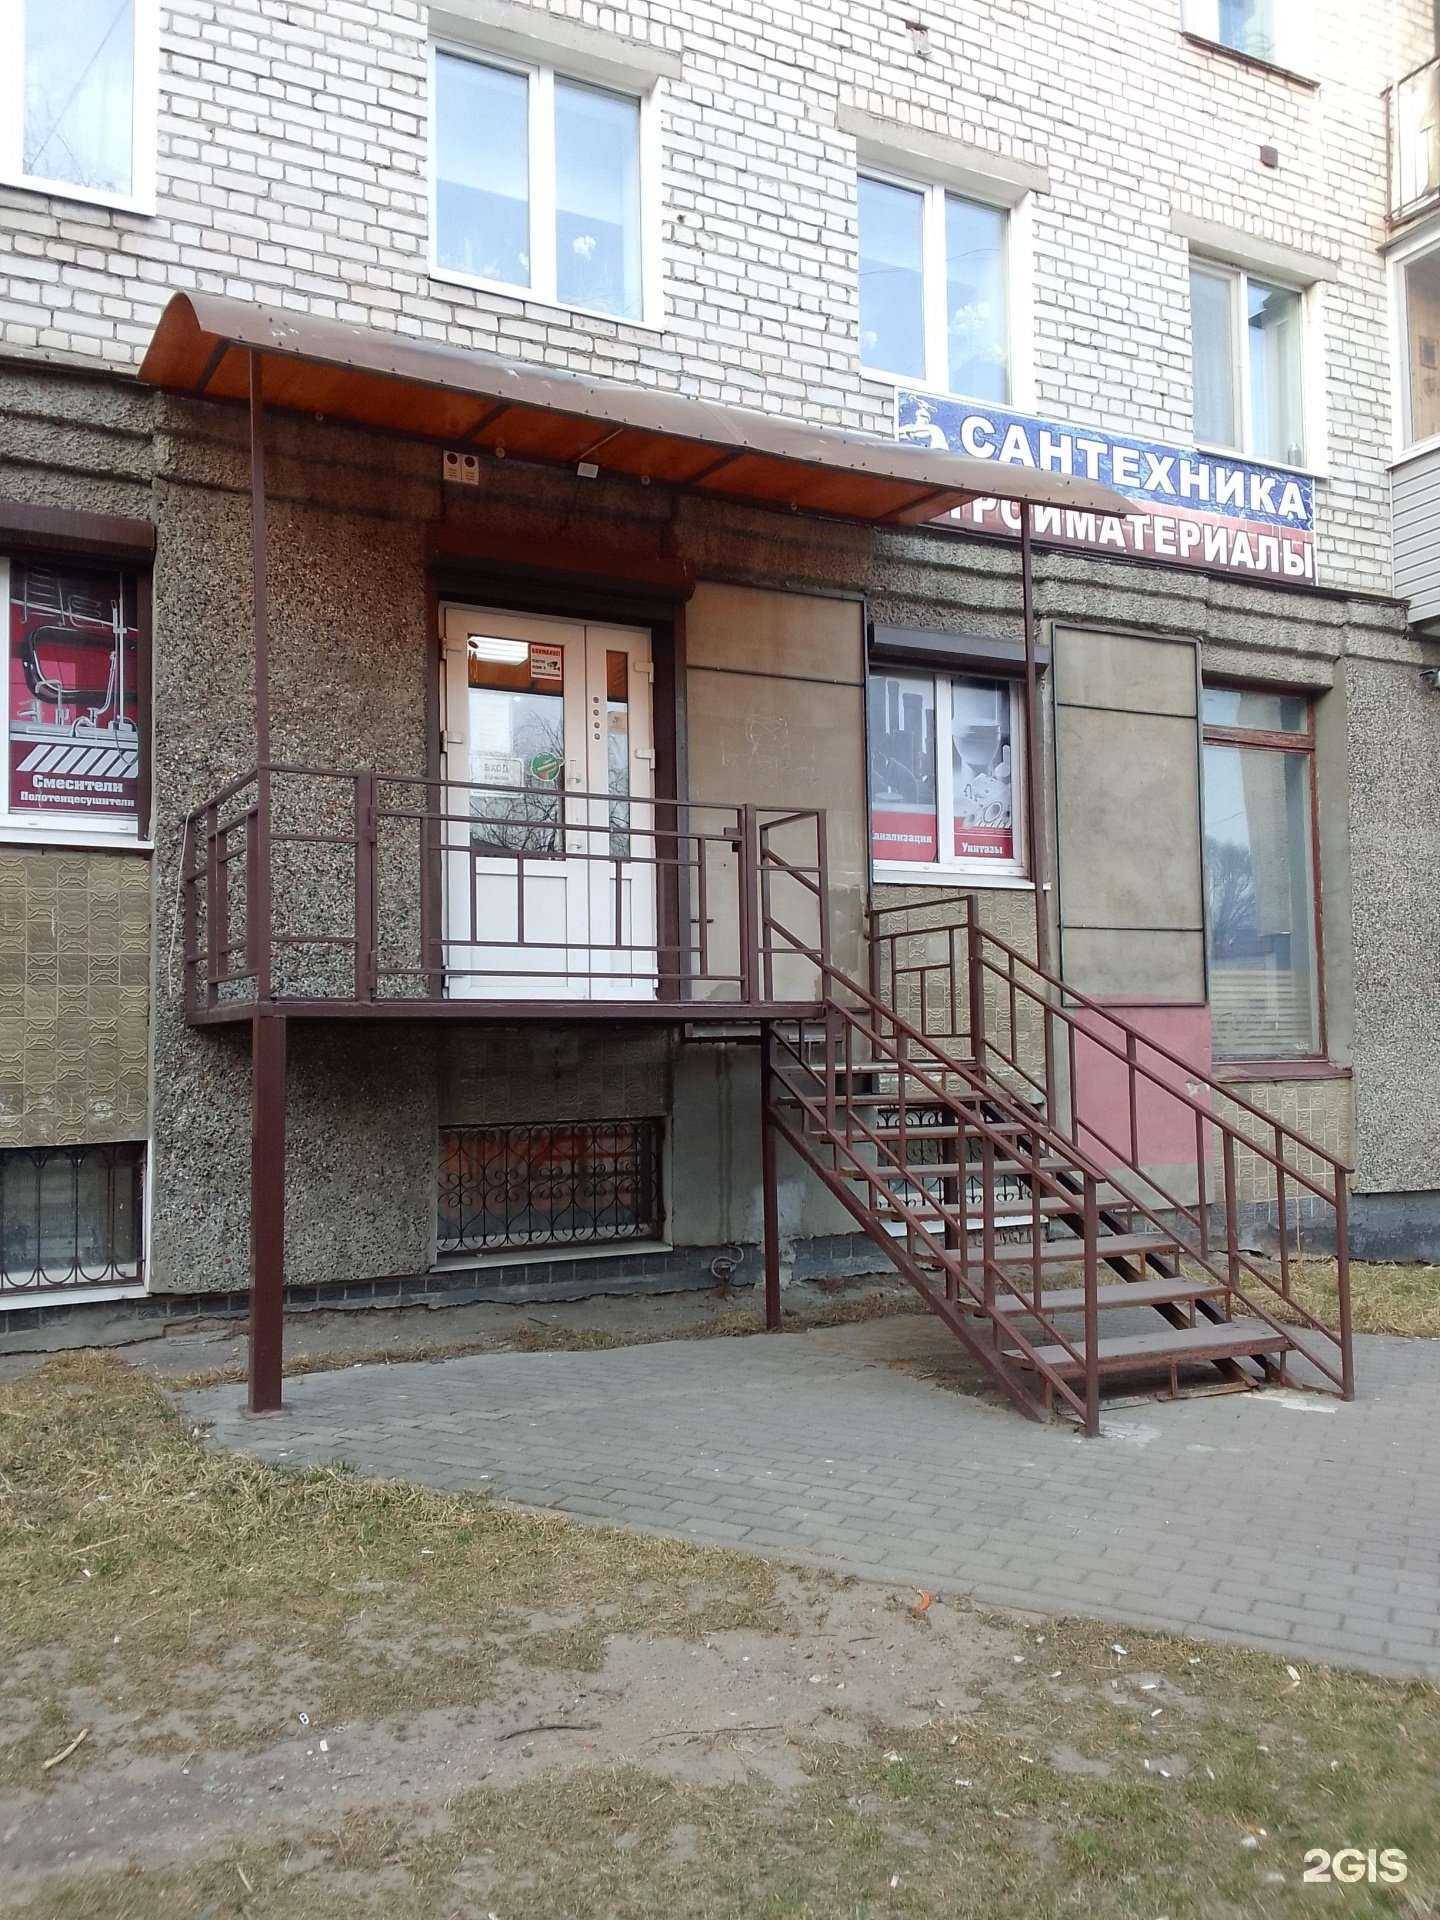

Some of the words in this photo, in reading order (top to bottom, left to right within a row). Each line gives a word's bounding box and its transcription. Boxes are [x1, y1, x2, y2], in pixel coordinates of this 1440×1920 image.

[960, 415, 1309, 520] САНТЕХНИКА
[32, 774, 124, 793] Смесители
[20, 791, 135, 807] Полотенцесушители
[961, 842, 1004, 854] Унитазы
